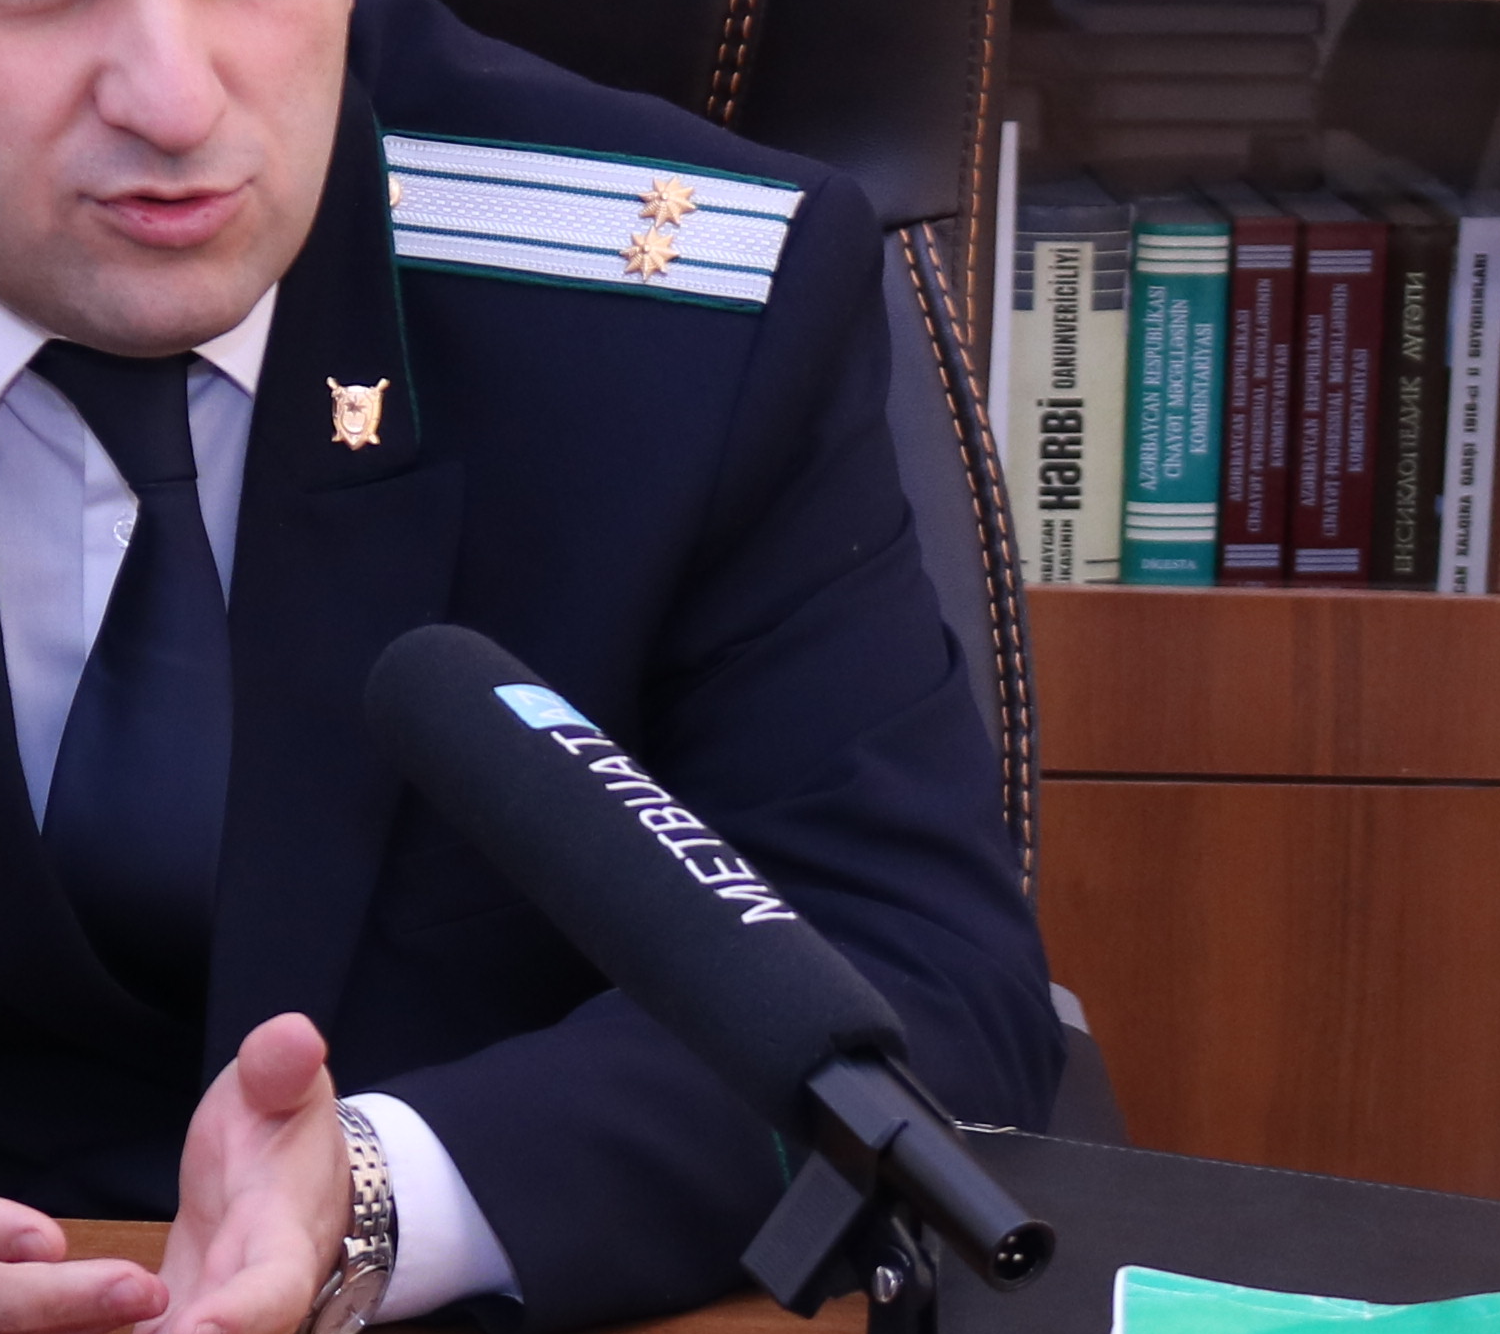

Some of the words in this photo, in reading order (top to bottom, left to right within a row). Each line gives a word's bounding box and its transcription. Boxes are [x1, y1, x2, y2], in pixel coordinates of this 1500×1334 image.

[1141, 285, 1167, 385] RESPUBLİKASI
[1164, 299, 1190, 408] MƏCƏLLƏSİNİN
[1230, 309, 1251, 408] RESPUBLİKASI
[1302, 314, 1324, 412] RESPUBLİKASI
[1189, 322, 1214, 455] KOMMENTARİYASI
[1139, 391, 1162, 491] AZƏRBAYCAN
[1163, 414, 1185, 479] CİNAYƏT
[1229, 413, 1248, 502] AZƏRBAYCAN
[1300, 417, 1320, 507] AZƏRBAYCAN
